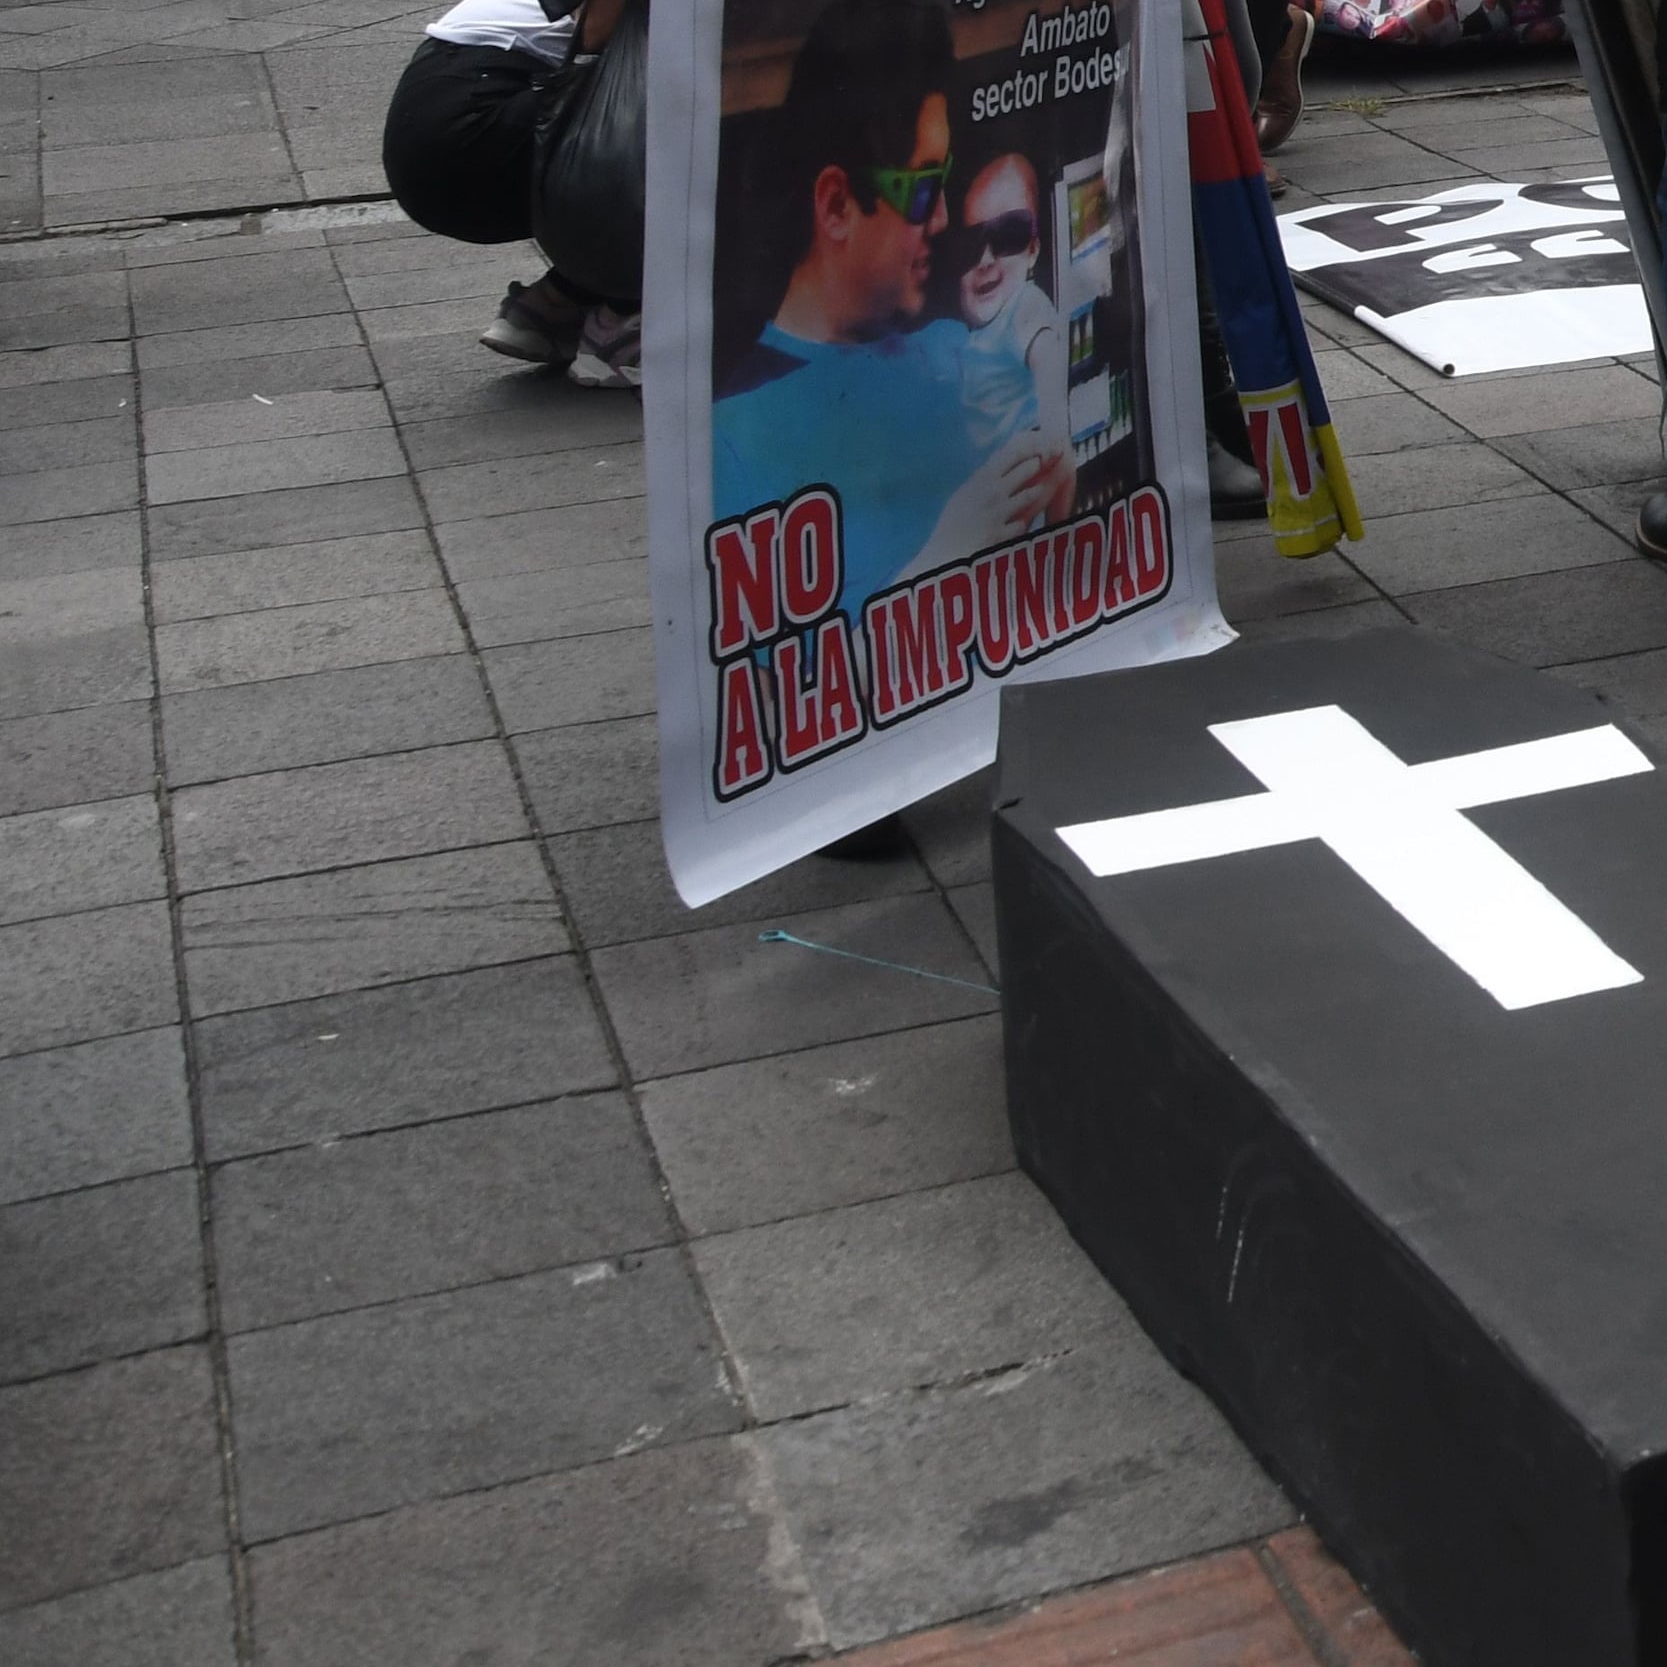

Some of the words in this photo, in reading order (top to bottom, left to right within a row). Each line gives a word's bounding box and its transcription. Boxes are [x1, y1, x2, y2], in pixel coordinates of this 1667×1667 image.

[1021, 4, 1111, 58] Ambato
[971, 68, 1049, 123] sector
[705, 482, 842, 666] NO
[712, 660, 774, 804] A
[771, 609, 868, 774] LA
[862, 478, 1174, 729] IMPUNIDAD
